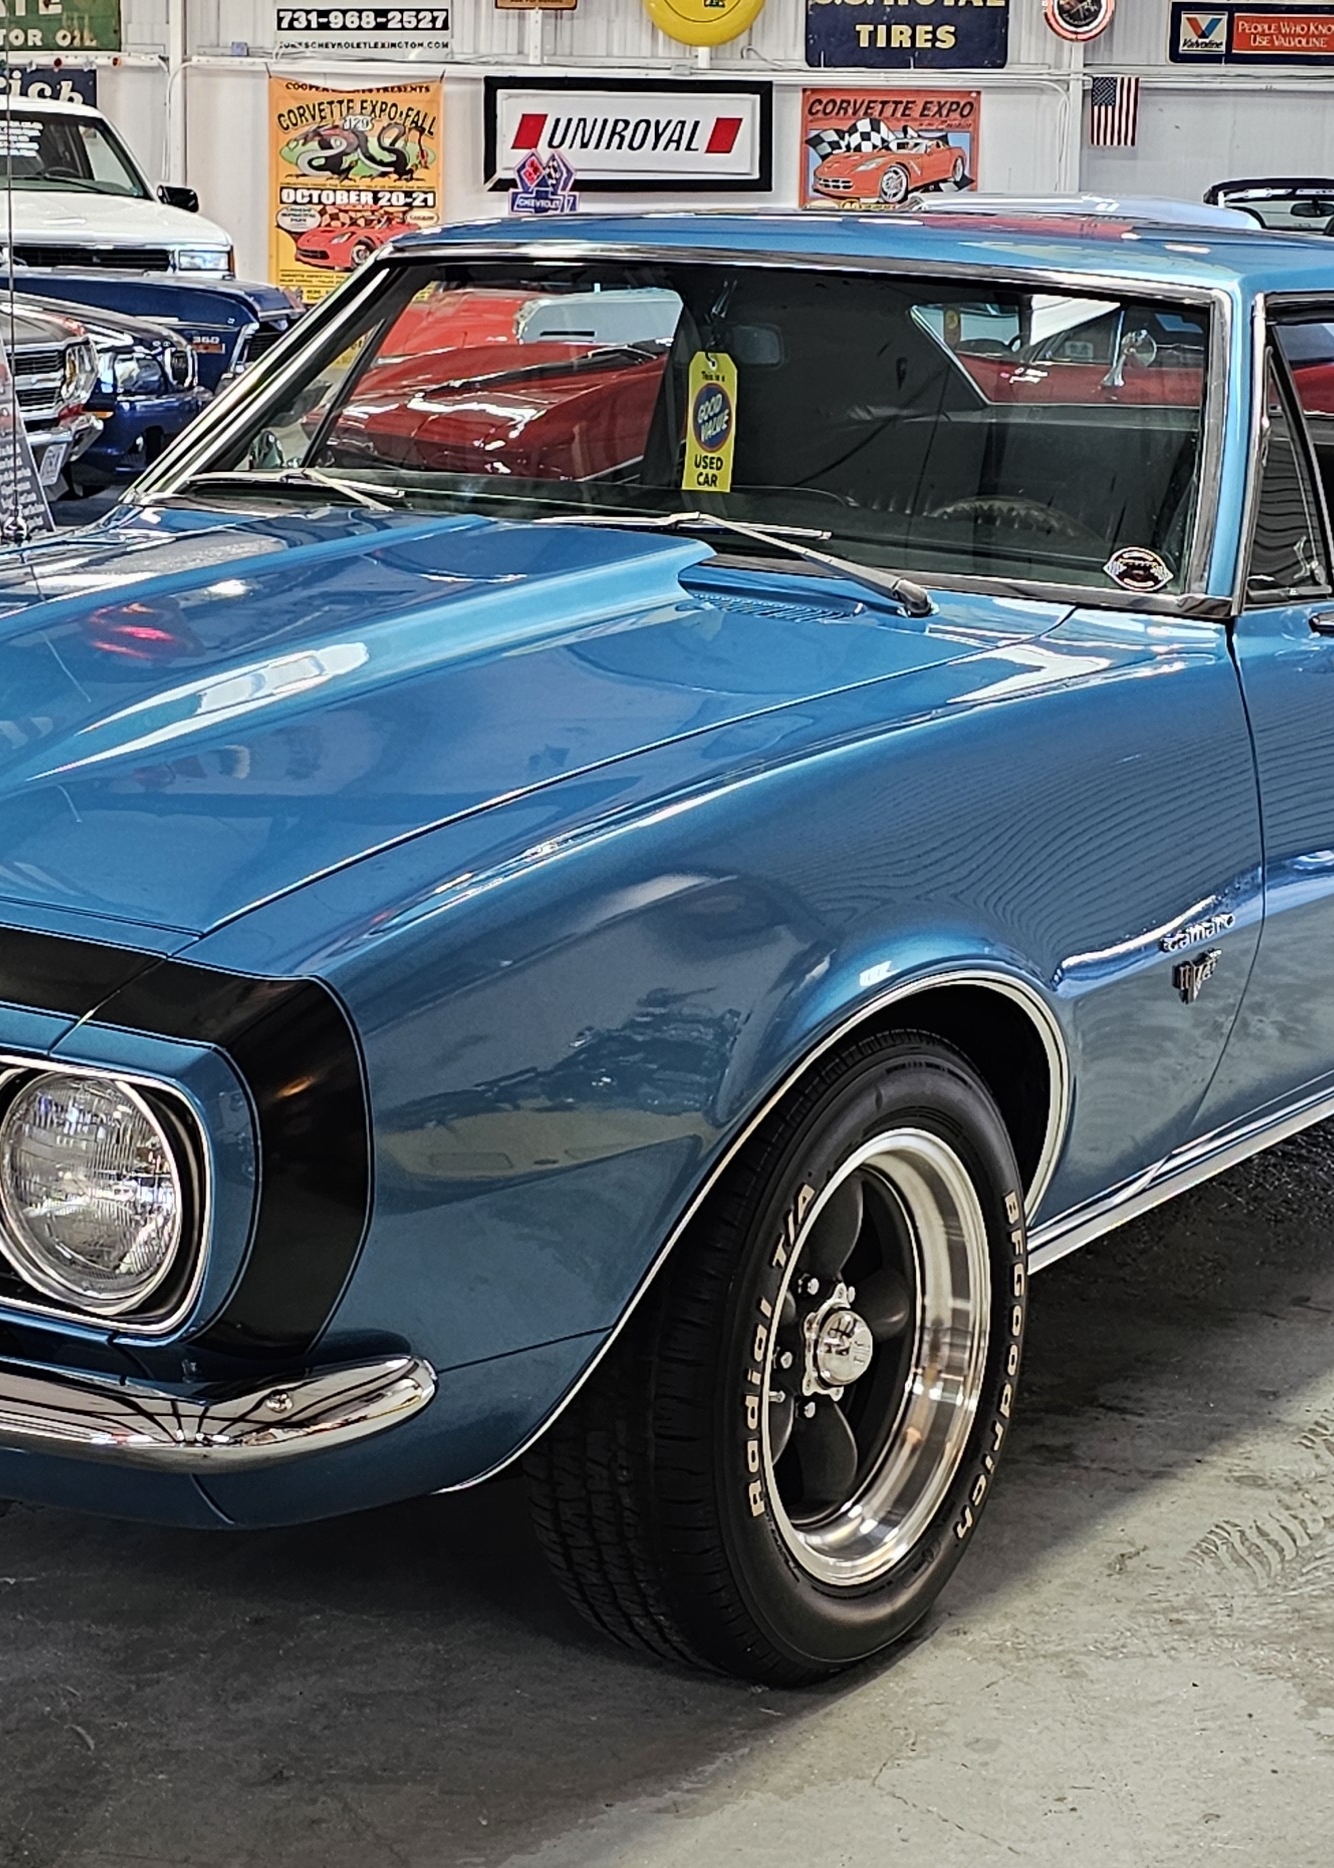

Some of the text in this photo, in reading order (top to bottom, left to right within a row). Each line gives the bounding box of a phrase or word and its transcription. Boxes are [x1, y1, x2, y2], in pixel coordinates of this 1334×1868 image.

[279, 11, 448, 29] 731-968-2527
[1238, 21, 1278, 34] PEOPLE
[1280, 22, 1307, 35] WHO
[55, 28, 98, 47] OIL
[855, 24, 956, 49] TIRES
[1182, 38, 1224, 50] Valvoline
[1250, 35, 1328, 48] USE VALVOLINE
[277, 99, 436, 136] CORVETTE EXPO FALL
[808, 99, 975, 119] CORVETTE EXPO
[547, 117, 701, 152] UNIROYAL
[280, 188, 435, 207] OCTOBER 20-21
[697, 393, 723, 423] GOOD
[700, 408, 730, 443] VALUE
[694, 454, 724, 471] USED
[696, 472, 718, 487] CAR
